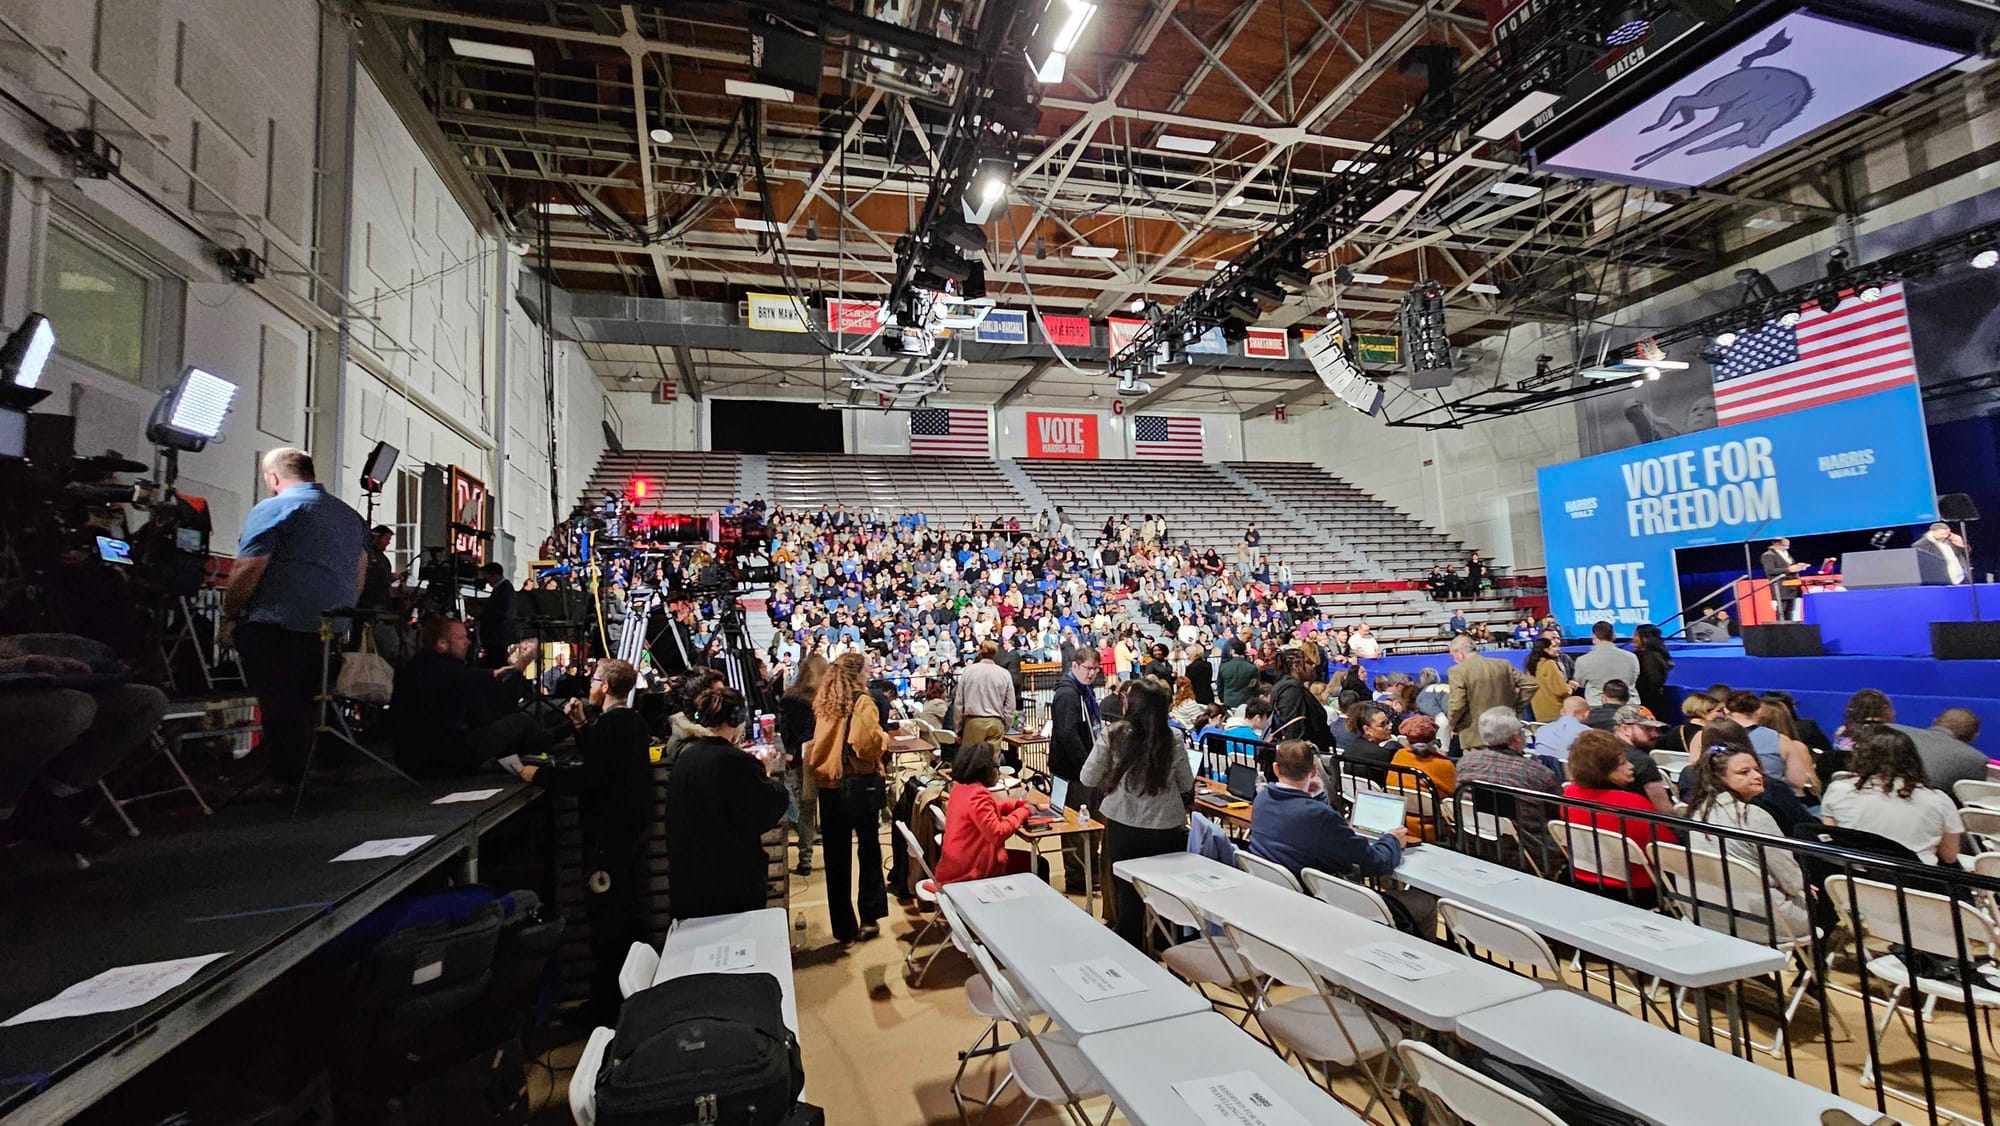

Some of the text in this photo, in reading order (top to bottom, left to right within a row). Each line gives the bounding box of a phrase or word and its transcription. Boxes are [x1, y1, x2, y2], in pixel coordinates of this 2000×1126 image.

[1606, 47, 1646, 80] MATCH
[1533, 106, 1555, 128] WON
[758, 306, 776, 319] BRYN
[663, 383, 677, 401] E
[1113, 400, 1124, 415] G
[1275, 407, 1285, 420] H
[1038, 416, 1084, 444] VOTE
[1042, 443, 1085, 454] HARRIS-WALZ
[1621, 436, 1776, 500] VOTE FOR
[1818, 449, 1875, 472] HARRIS
[1827, 465, 1868, 479] WALZ
[1565, 497, 1598, 513] HARRIS
[1627, 477, 1781, 537] FREEDOM
[1565, 562, 1649, 610] VOTE
[1574, 608, 1651, 625] HARRIS-WALZ
